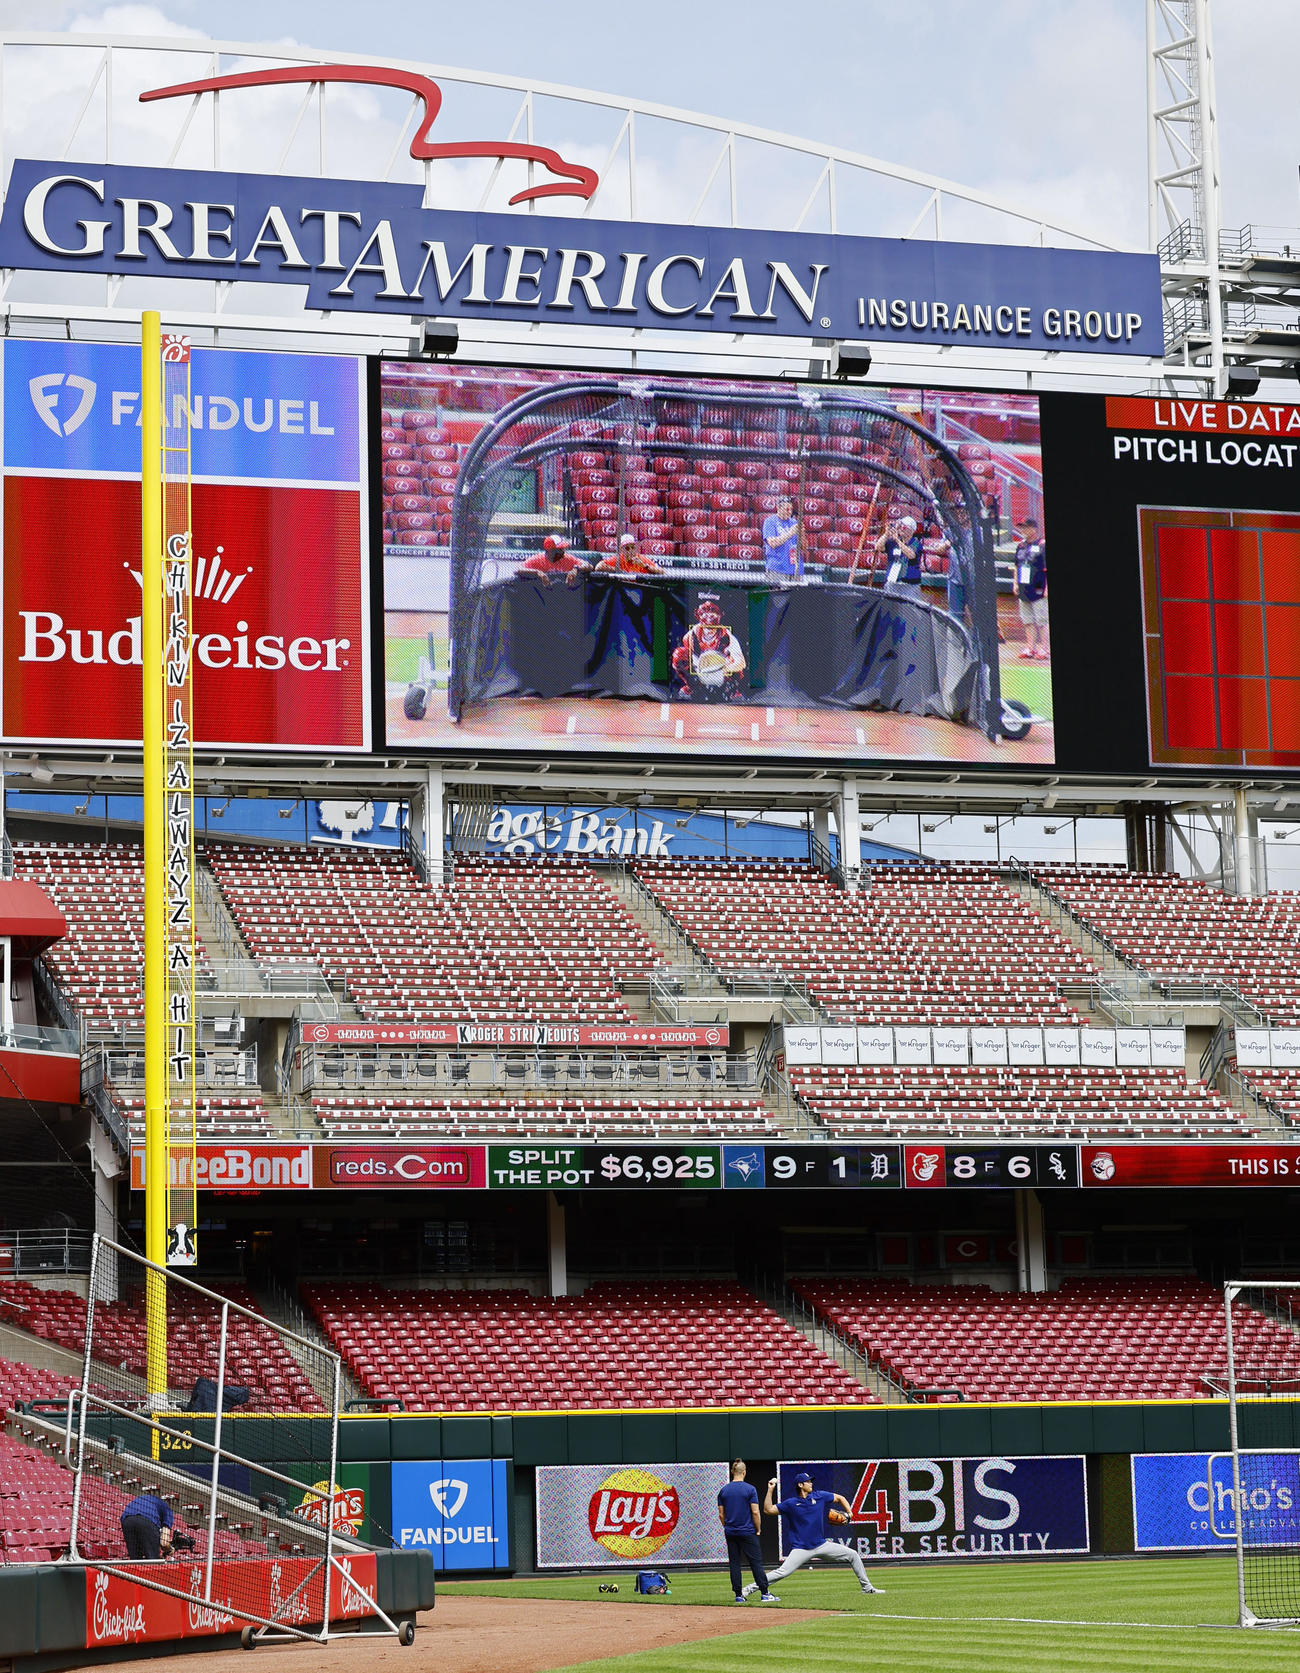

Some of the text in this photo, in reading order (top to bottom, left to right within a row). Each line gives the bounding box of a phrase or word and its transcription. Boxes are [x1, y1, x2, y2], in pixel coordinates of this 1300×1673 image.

[23, 174, 1142, 342] GREAT AMERICAN INSURANCE GROUP
[1154, 401, 1300, 432] LIVE DATA
[1113, 436, 1198, 463] PITCH
[563, 811, 675, 855] Bank
[169, 993, 191, 1081] HIT
[458, 1026, 504, 1043] KROGER
[797, 1038, 818, 1050] Kroger
[834, 1038, 854, 1050] Kroger
[870, 1038, 890, 1050] Kroger
[908, 1038, 928, 1050] Kroger
[945, 1039, 966, 1052] Kroger
[983, 1039, 1004, 1052] Kroger
[1020, 1040, 1040, 1052] Kroger
[1057, 1040, 1077, 1052] Kroger
[1093, 1041, 1114, 1053] Kroger
[1128, 1040, 1148, 1052] Kroger
[1162, 1040, 1182, 1052] Kroger
[1248, 1041, 1268, 1053] Kroger
[508, 1149, 575, 1164] SPLIT
[133, 1149, 309, 1185] TreeBond
[600, 1153, 715, 1183] $6,925
[772, 1155, 797, 1179] 9
[805, 1161, 816, 1173] F
[832, 1156, 846, 1178] 1
[953, 1155, 977, 1178] 8
[984, 1161, 995, 1173] F
[1007, 1155, 1031, 1178] 6
[1228, 1158, 1269, 1175] THIS
[1274, 1158, 1289, 1175] IS
[494, 1169, 594, 1184] THE POT
[850, 1459, 1020, 1534] 4BIS
[594, 1490, 675, 1540] Lay's
[401, 1526, 499, 1546] FANDUEL
[920, 1531, 1050, 1556] SECURITY
